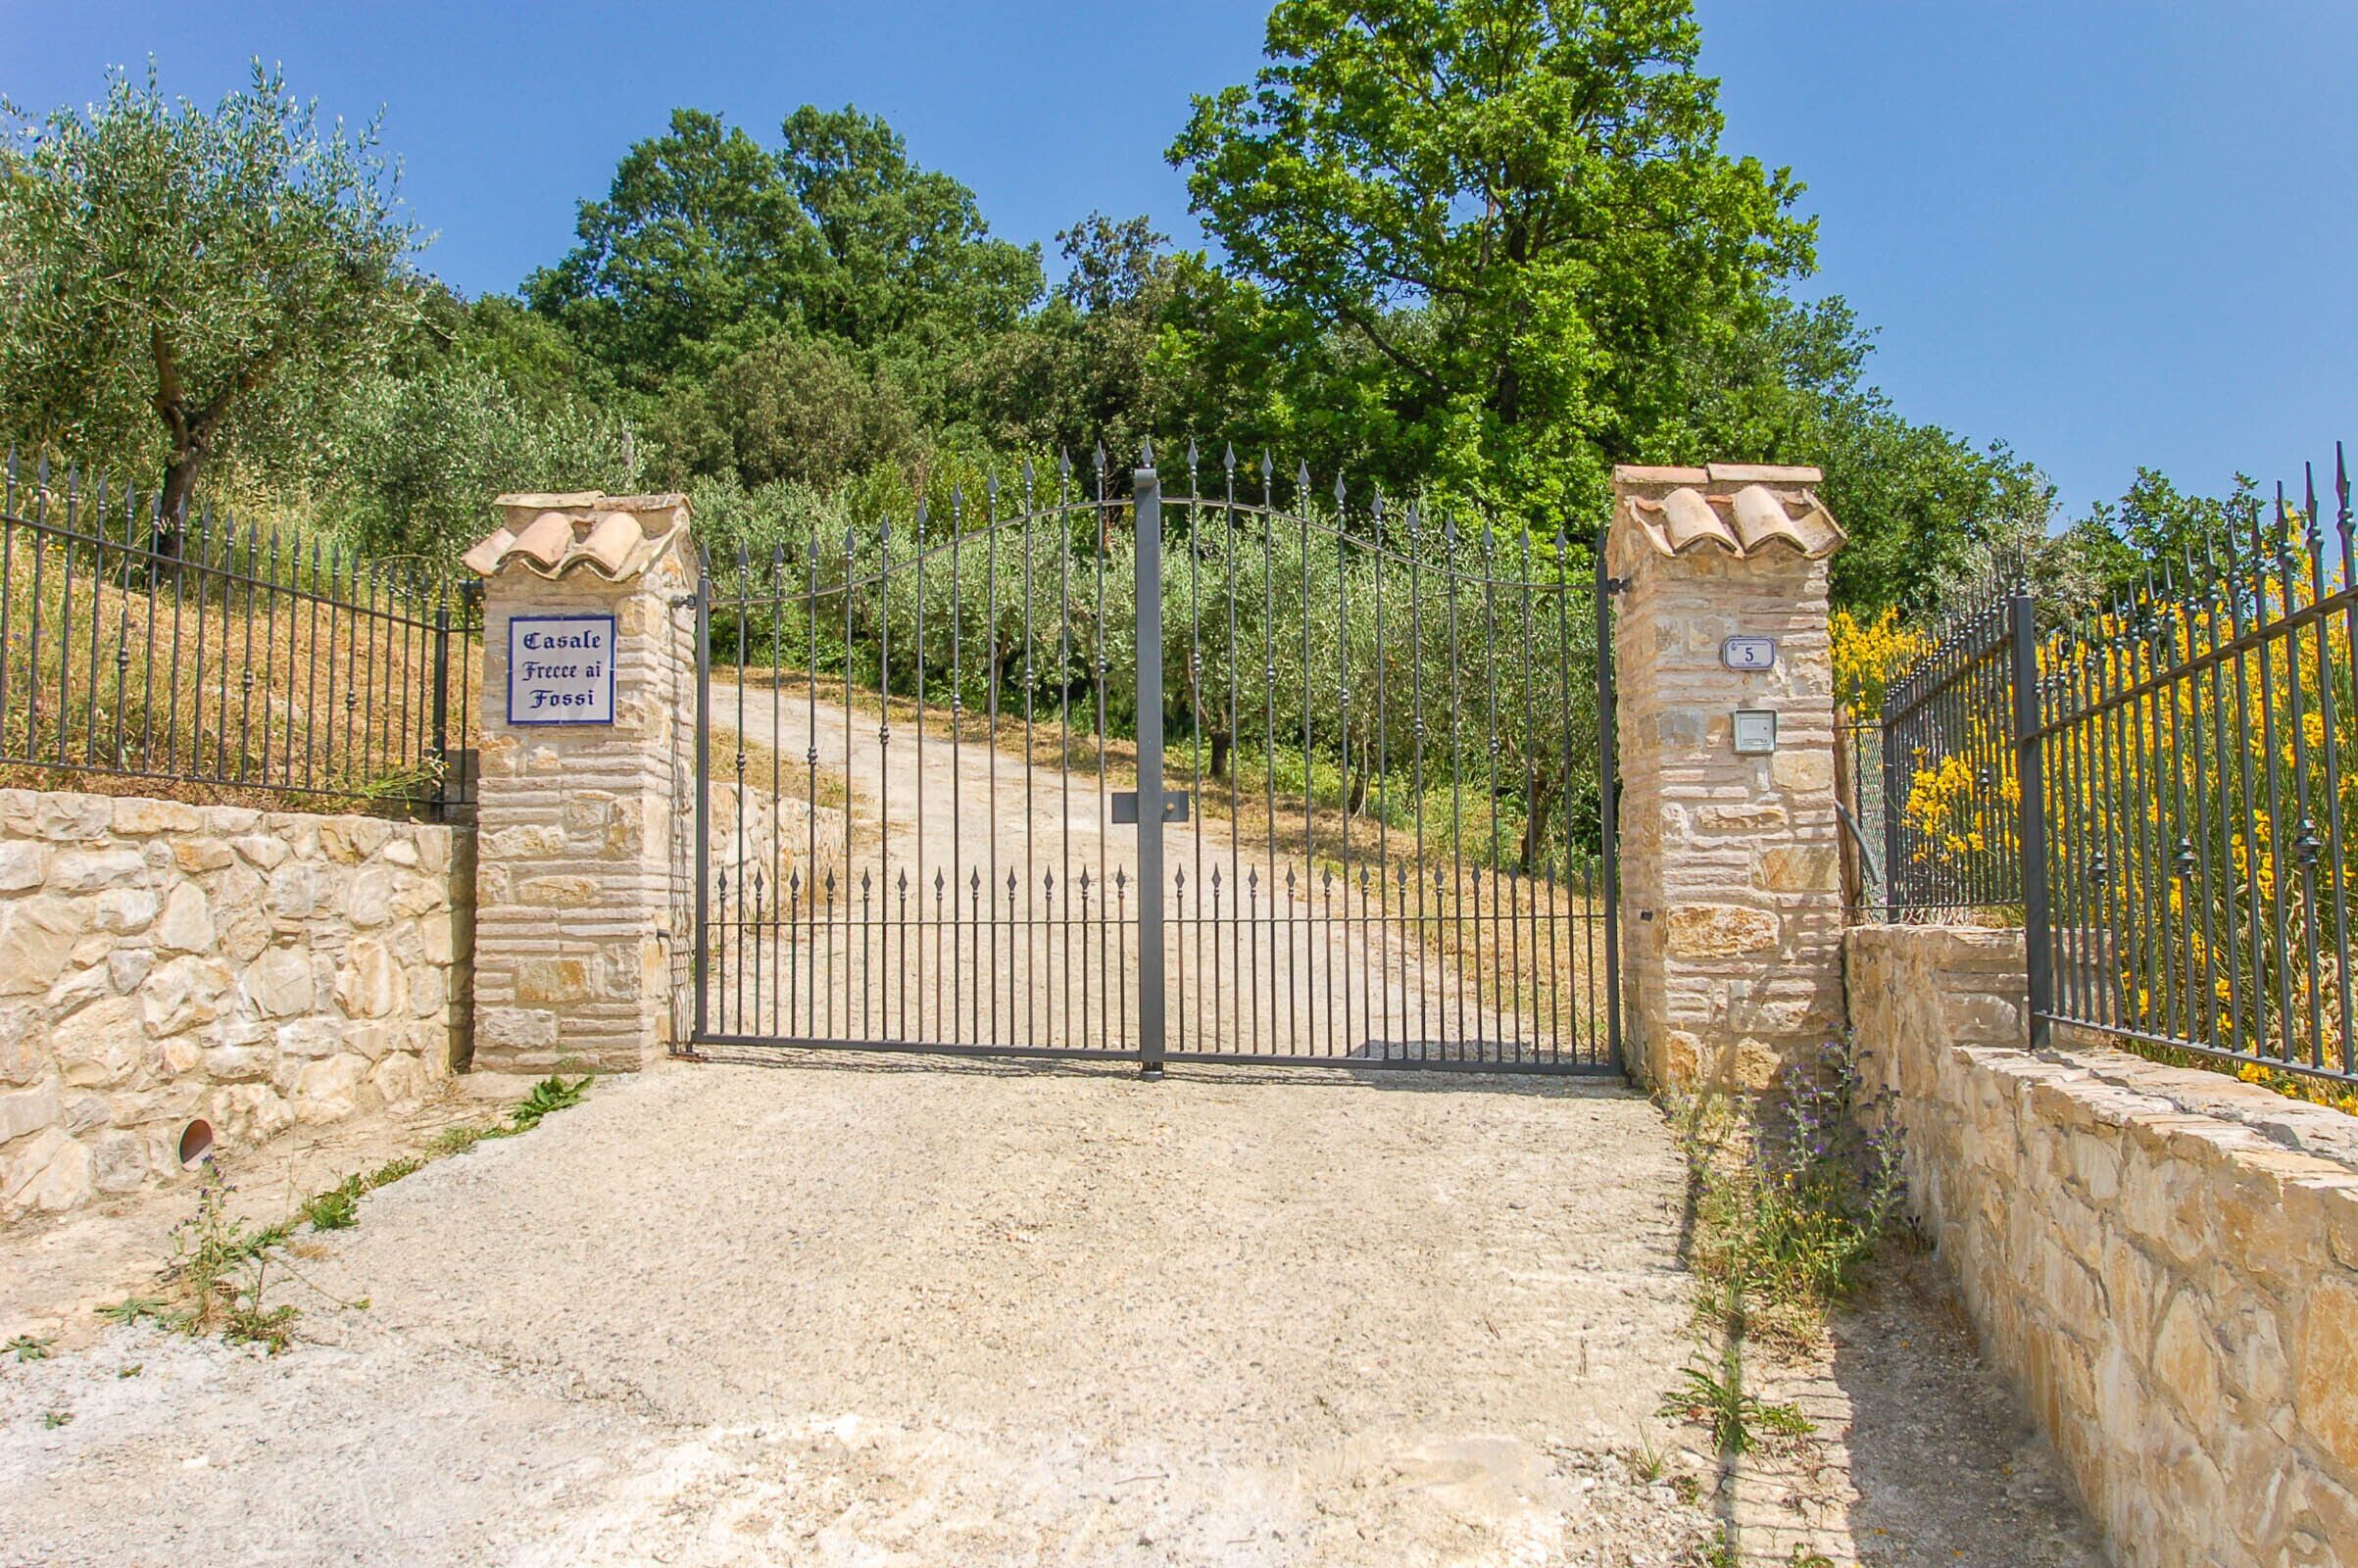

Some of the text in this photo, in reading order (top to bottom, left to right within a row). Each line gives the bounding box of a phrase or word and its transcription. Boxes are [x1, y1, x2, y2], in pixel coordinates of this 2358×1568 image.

[522, 629, 602, 651] Casale
[1745, 647, 1754, 662] 5
[521, 661, 602, 681] Frecce ai
[529, 689, 595, 709] Fossi
